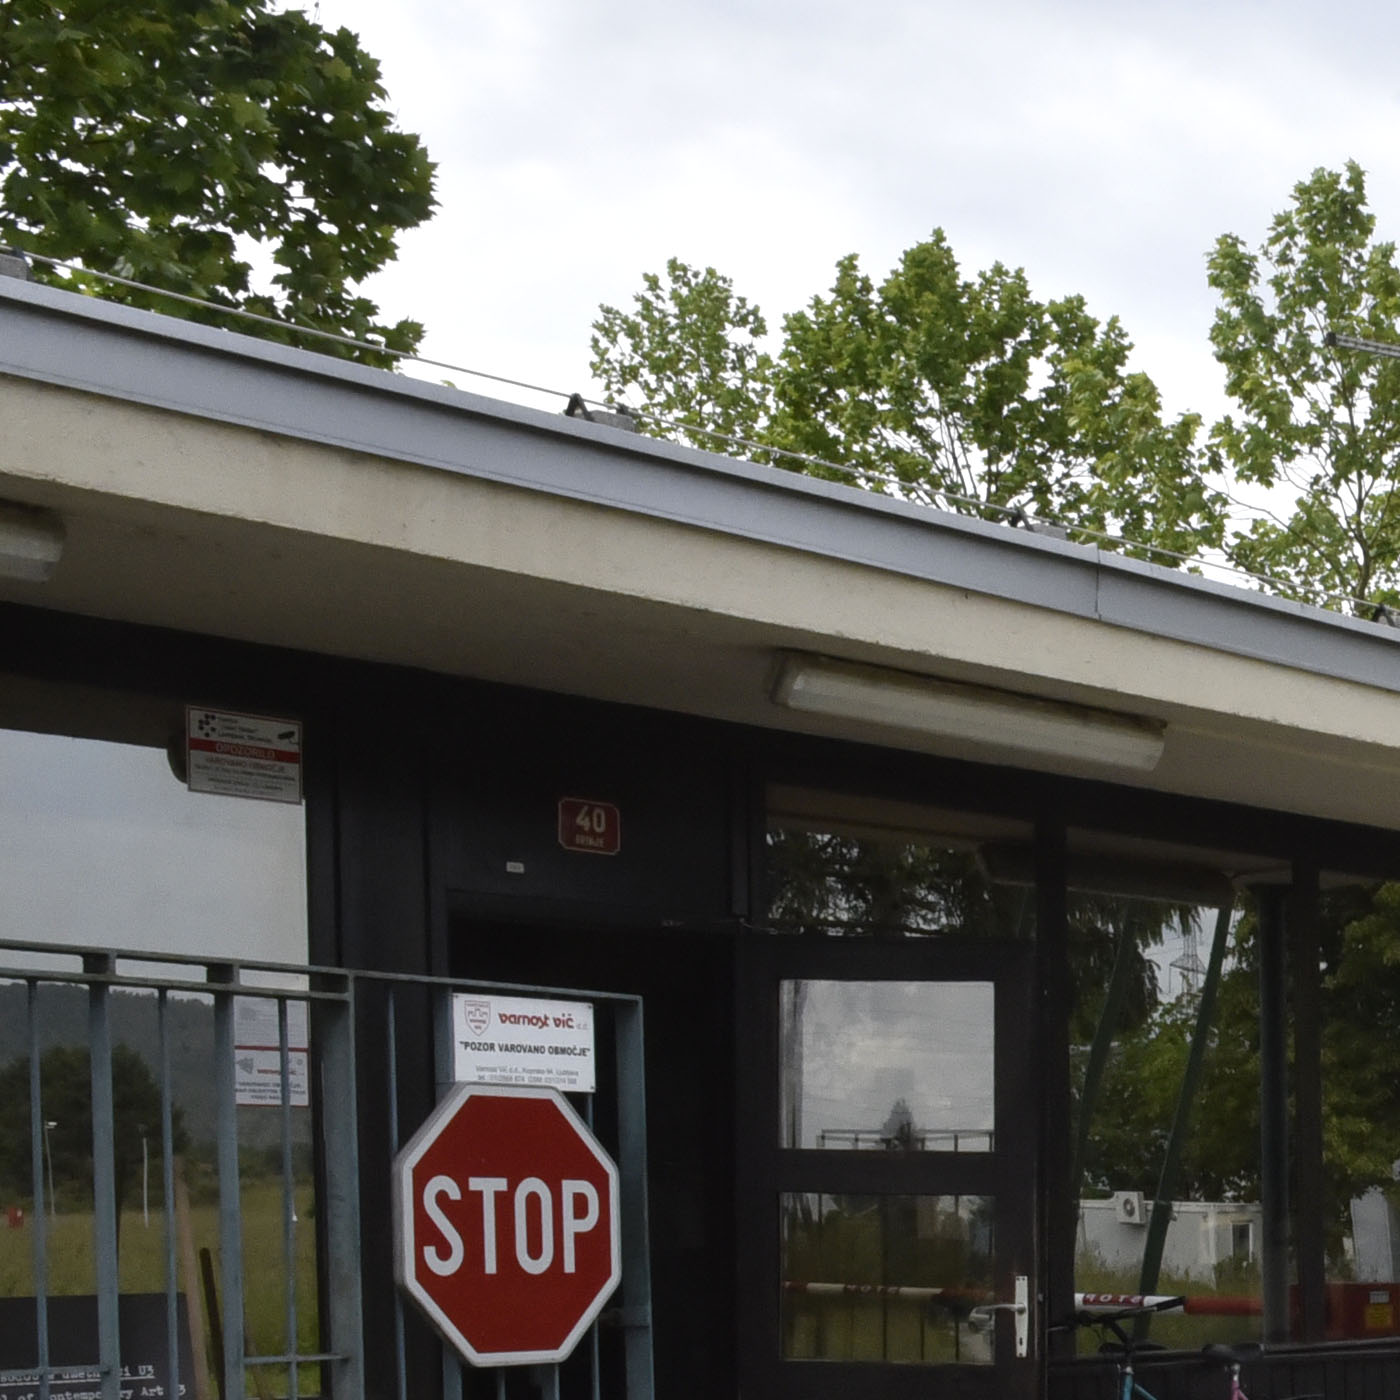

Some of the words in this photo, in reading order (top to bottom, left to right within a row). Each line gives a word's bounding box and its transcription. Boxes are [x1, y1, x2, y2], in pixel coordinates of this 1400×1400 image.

[575, 804, 606, 833] 40
[498, 1012, 549, 1029] varnost
[498, 1043, 546, 1055] VAROVANO
[422, 1174, 600, 1277] STOP
[140, 1384, 164, 1397] Art
